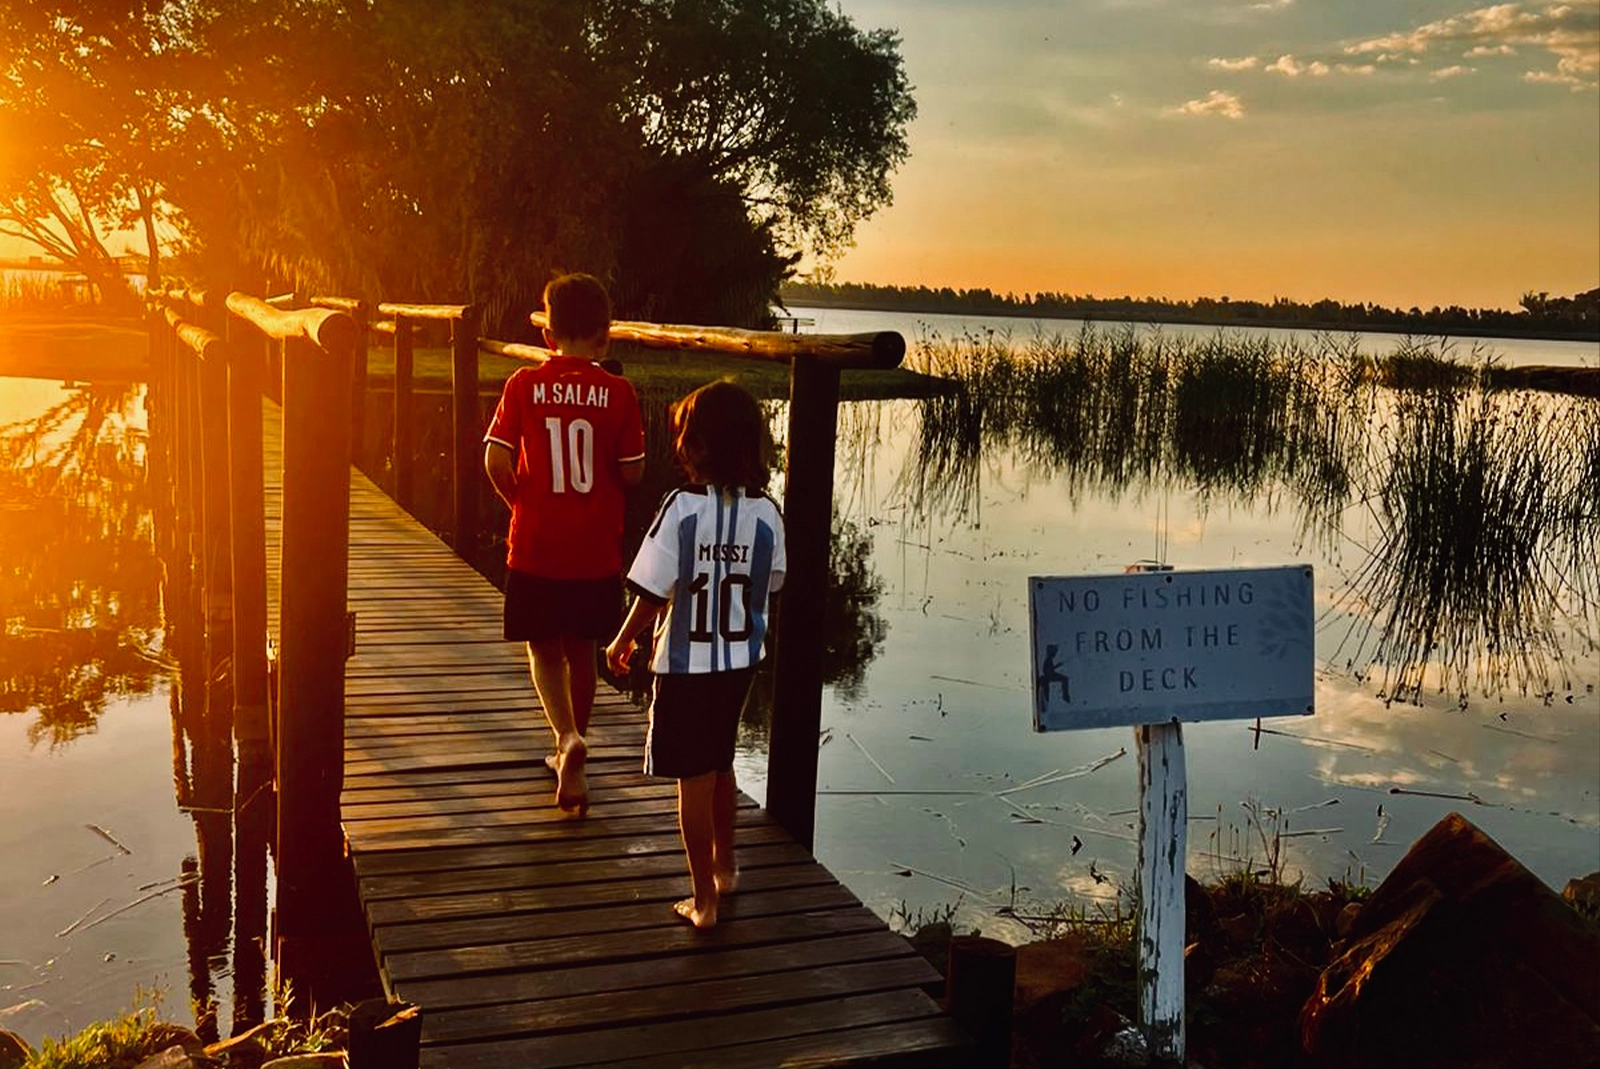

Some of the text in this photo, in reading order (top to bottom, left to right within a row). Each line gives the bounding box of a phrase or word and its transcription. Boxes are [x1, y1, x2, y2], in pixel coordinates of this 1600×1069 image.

[533, 383, 609, 408] M.SALAH
[545, 417, 593, 493] 10
[699, 543, 750, 563] MESSI
[688, 572, 754, 642] 10
[1059, 582, 1255, 613] NO FISHING
[1075, 624, 1240, 652] FROM THE
[1119, 667, 1198, 692] DECK
